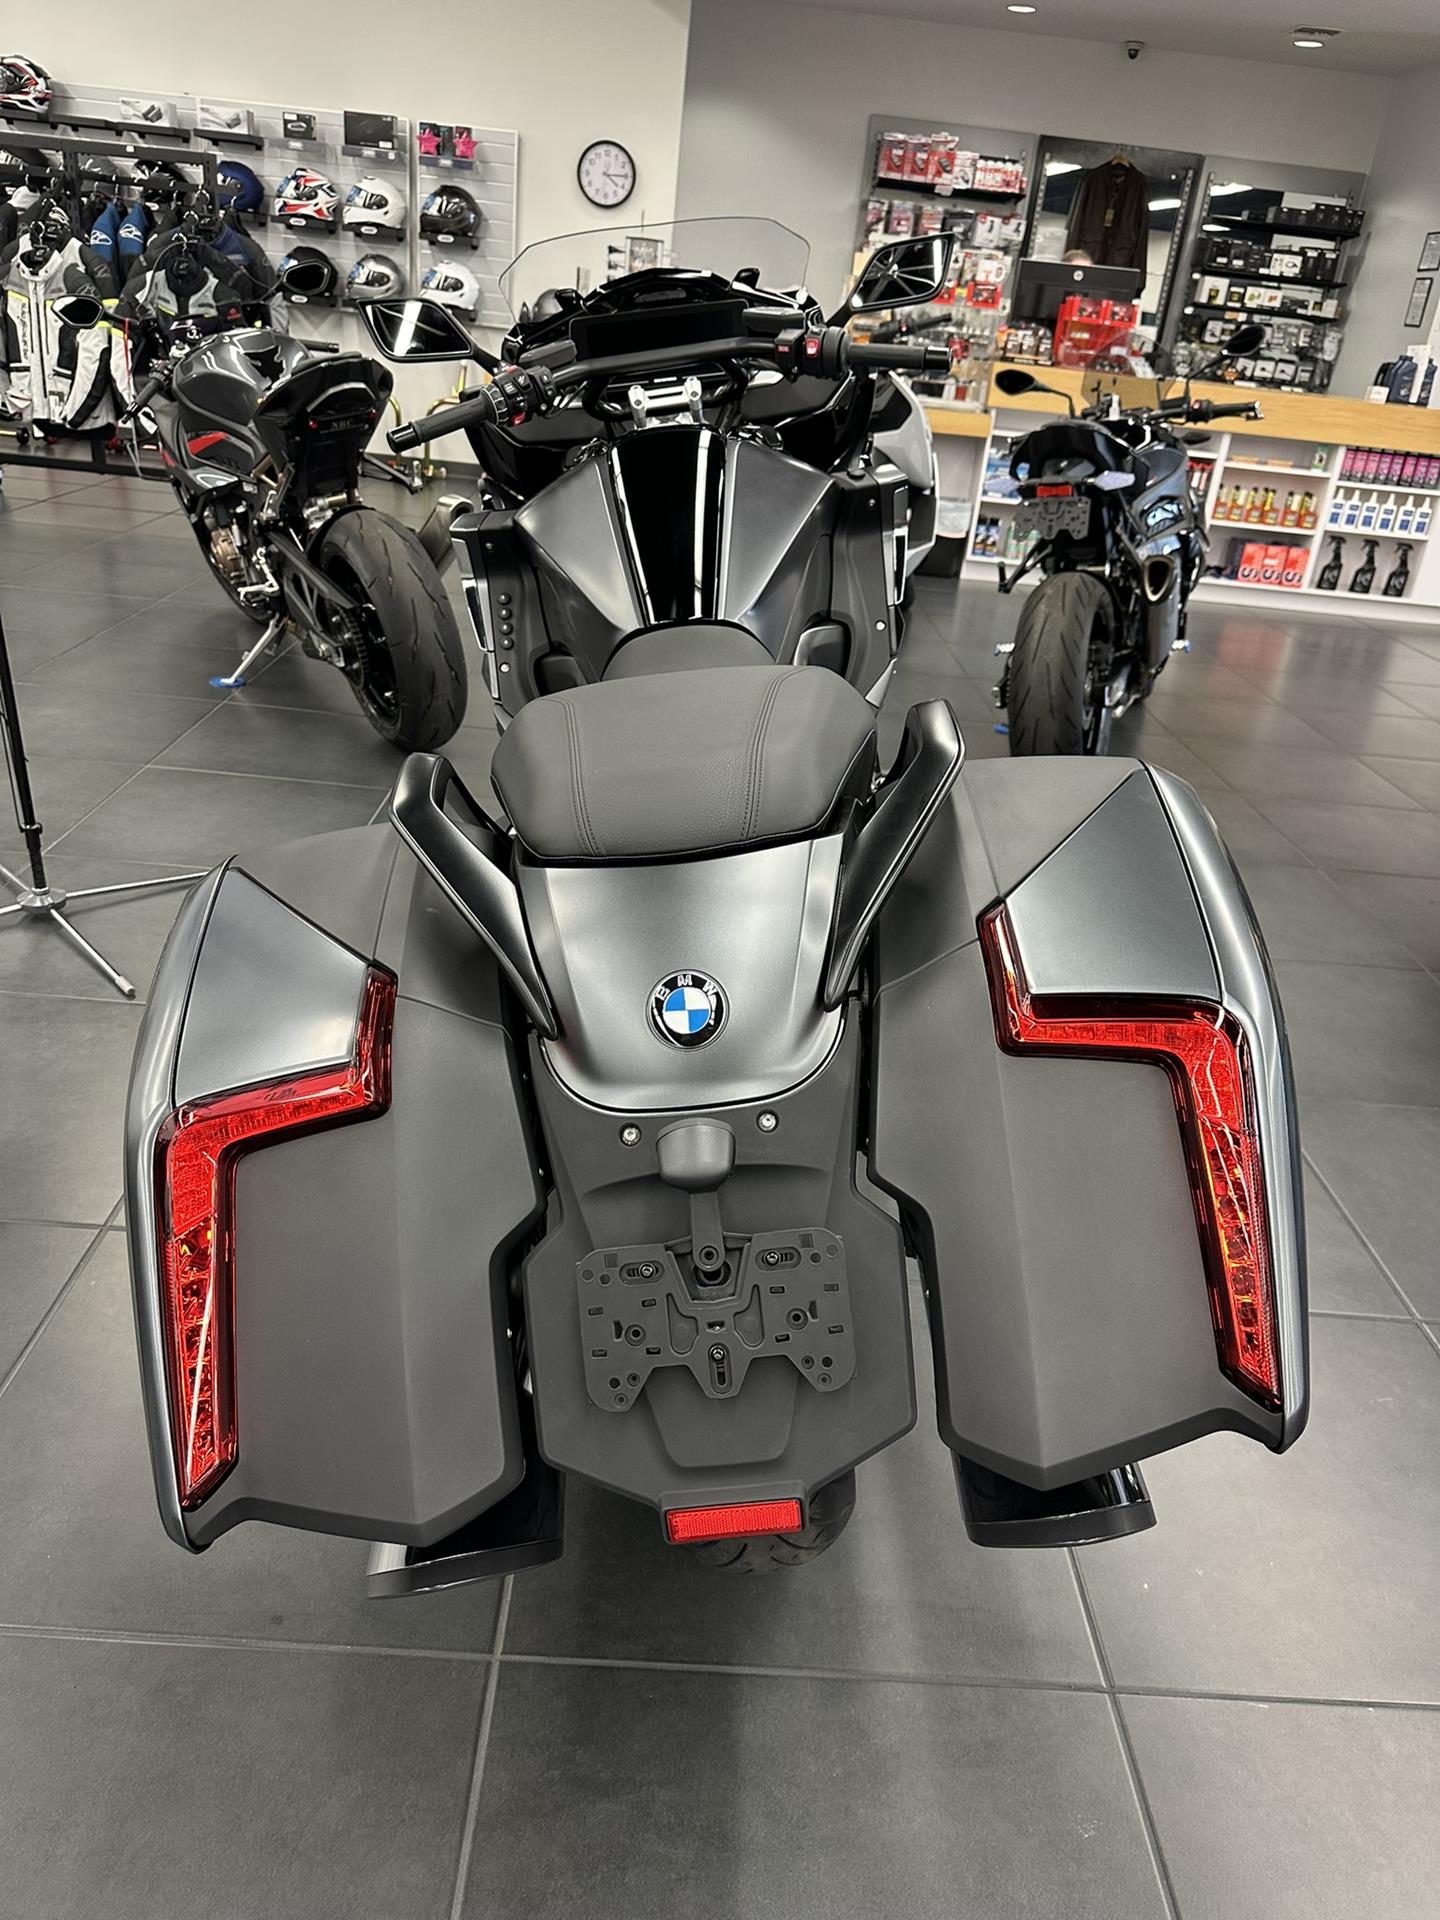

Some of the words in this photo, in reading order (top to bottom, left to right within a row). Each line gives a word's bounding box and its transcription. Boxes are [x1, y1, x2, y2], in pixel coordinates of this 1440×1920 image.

[604, 149, 611, 157] 12
[620, 161, 626, 169] 2
[655, 974, 718, 1001] BMW
